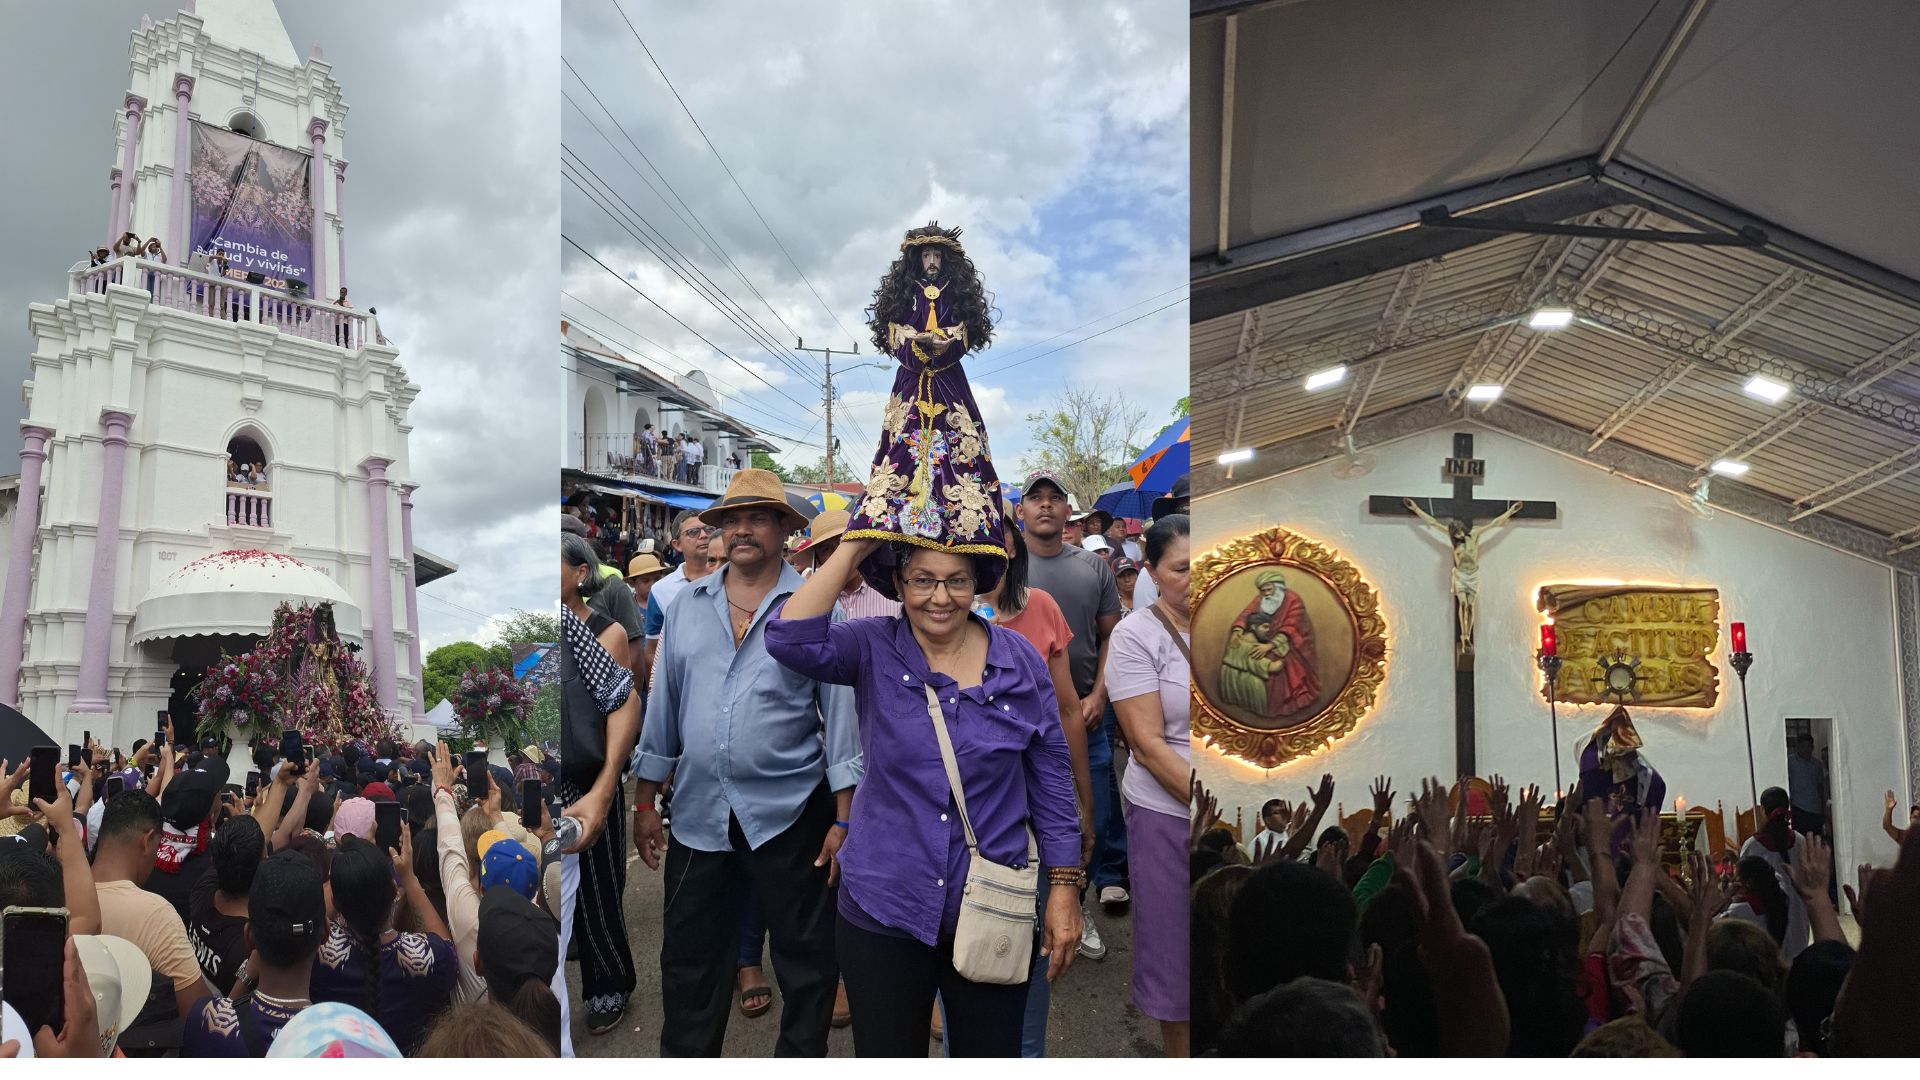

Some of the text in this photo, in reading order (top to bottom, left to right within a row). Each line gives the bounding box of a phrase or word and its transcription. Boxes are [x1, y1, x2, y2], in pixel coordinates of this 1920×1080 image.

[245, 256, 254, 267] y
[271, 249, 289, 262] de
[264, 276, 287, 290] 202
[1447, 459, 1485, 475] INRI
[1583, 595, 1705, 624] CAMBIA
